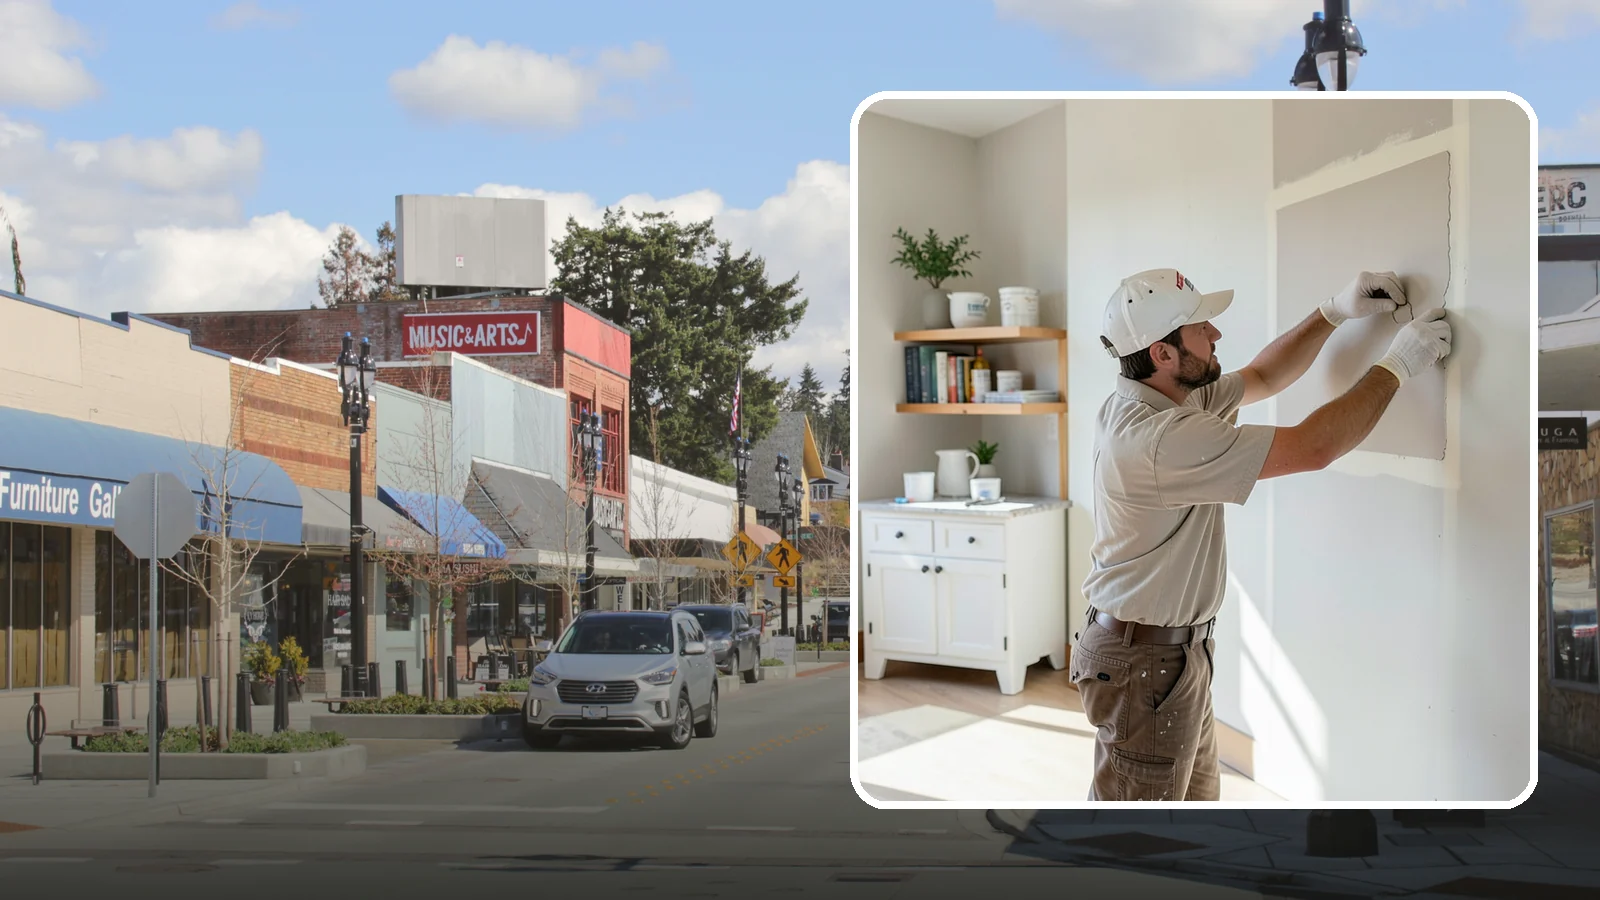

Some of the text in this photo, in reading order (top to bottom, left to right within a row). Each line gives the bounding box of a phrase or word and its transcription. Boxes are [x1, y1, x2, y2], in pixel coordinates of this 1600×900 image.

[409, 323, 519, 348] MUSIC&ARTS
[1540, 428, 1577, 436] UGA
[0, 471, 122, 519] Furniture Gal
